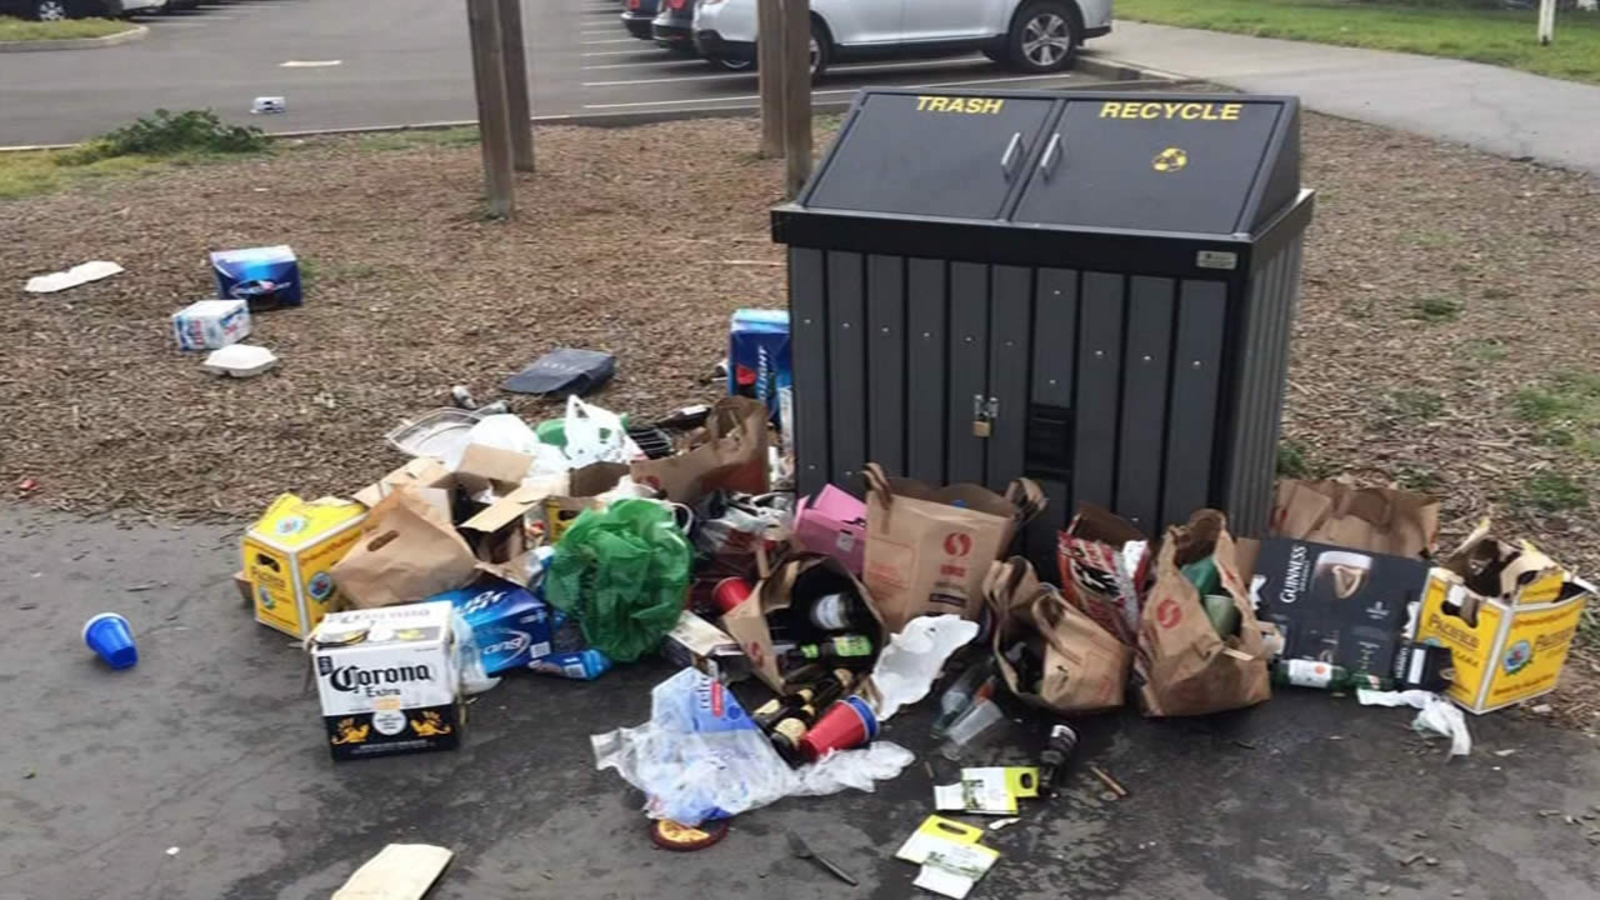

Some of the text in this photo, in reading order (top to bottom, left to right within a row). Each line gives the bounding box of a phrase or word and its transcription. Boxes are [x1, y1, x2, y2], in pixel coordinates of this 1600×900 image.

[915, 96, 1004, 115] TRASH
[1099, 102, 1242, 120] RECYCLE
[1280, 545, 1308, 604] GUINNESS
[330, 664, 434, 694] Corona
[365, 686, 402, 698] Extra
